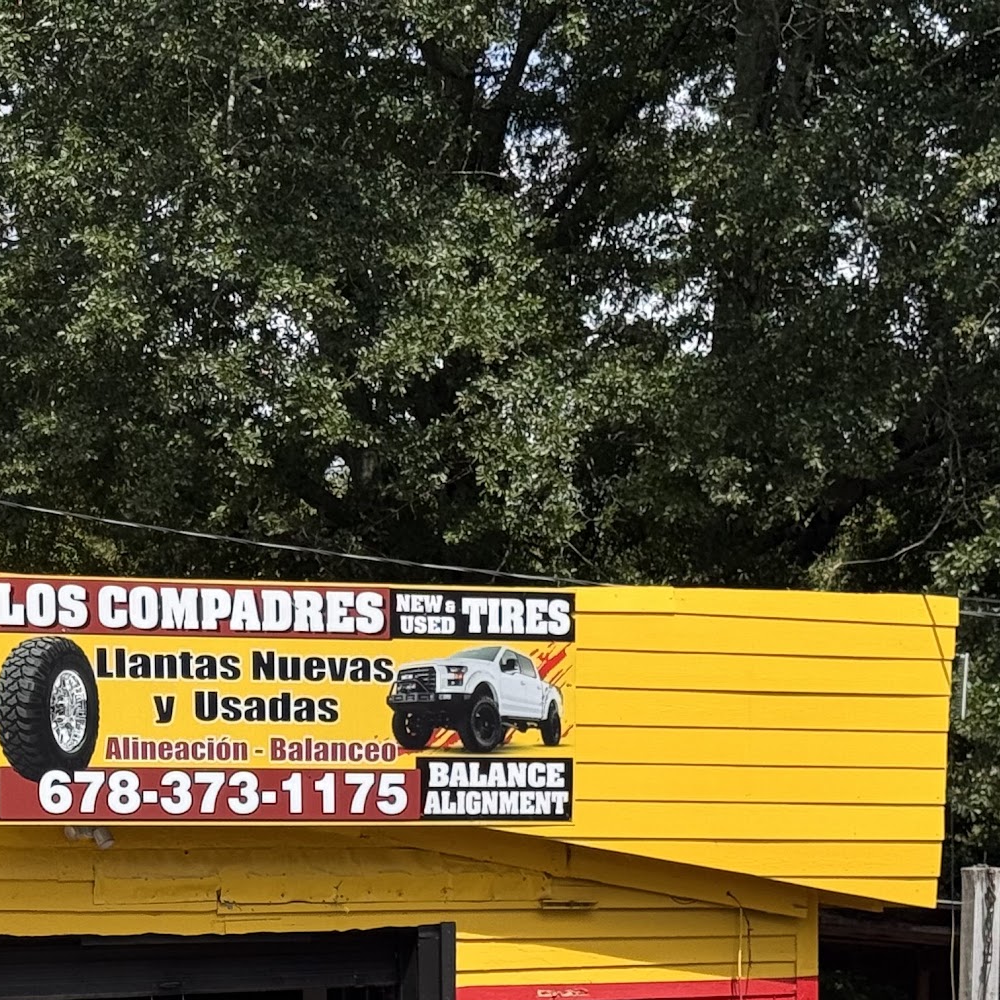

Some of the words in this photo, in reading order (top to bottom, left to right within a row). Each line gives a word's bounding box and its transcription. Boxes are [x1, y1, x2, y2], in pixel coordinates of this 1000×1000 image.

[98, 585, 386, 635] COMPADRES
[396, 594, 443, 613] NEW
[445, 601, 455, 612] &
[462, 597, 570, 636] TIRES
[400, 615, 455, 634] USED
[96, 648, 241, 680] Llantas
[252, 651, 393, 682] Nuevas
[154, 696, 175, 723] y
[195, 691, 339, 723] Usadas
[105, 737, 248, 761] Alineación
[270, 738, 397, 762] Balanceo
[429, 762, 565, 788] BALANCE
[38, 770, 408, 815] 678-373-1175
[424, 791, 569, 816] ALIGNMENT
